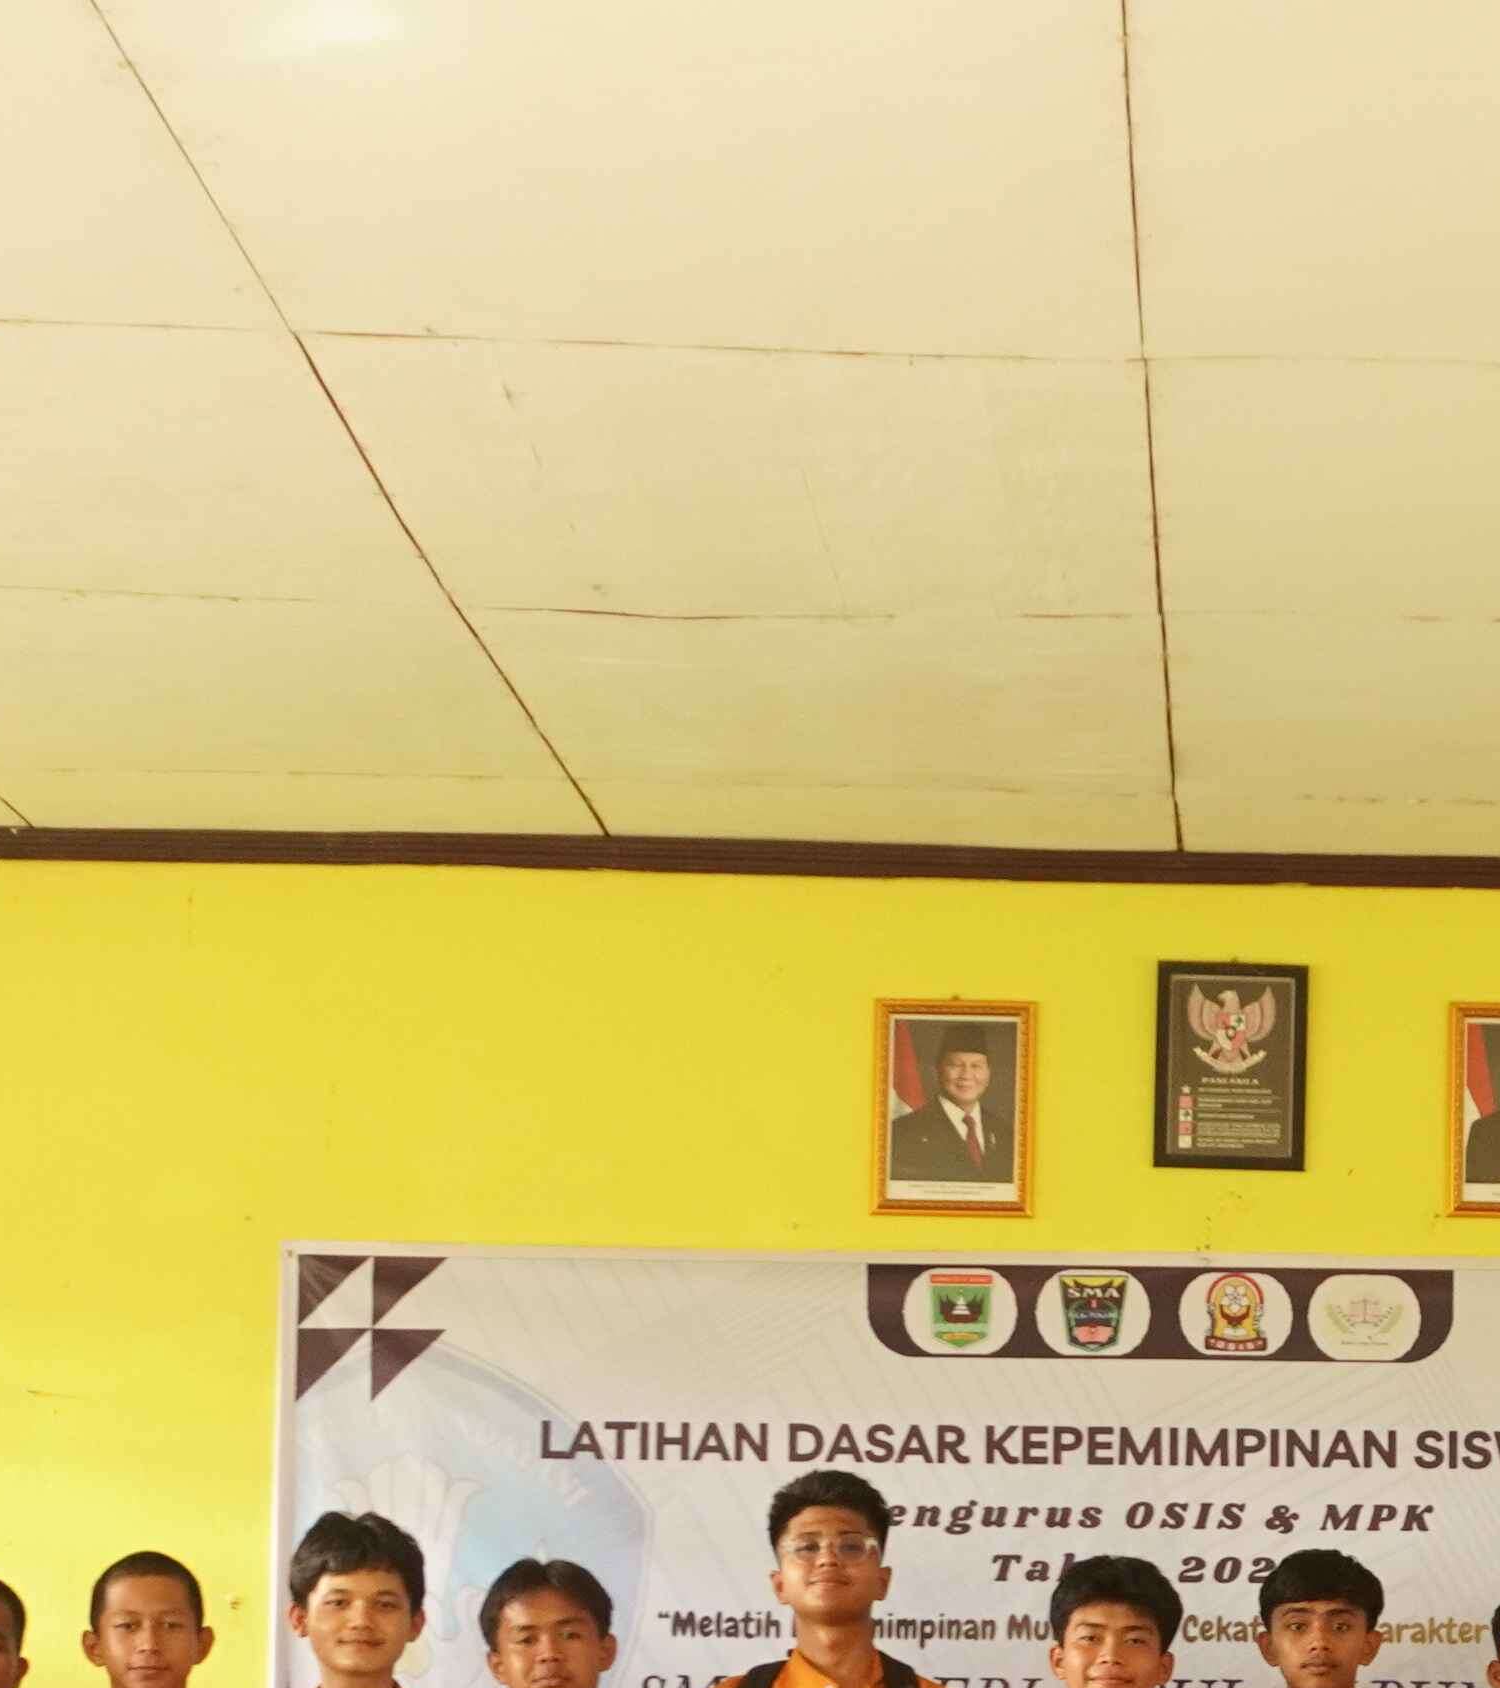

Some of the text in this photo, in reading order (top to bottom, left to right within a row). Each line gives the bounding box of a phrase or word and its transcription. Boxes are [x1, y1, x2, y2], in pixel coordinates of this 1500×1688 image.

[1067, 1287, 1121, 1298] SMA
[541, 1420, 768, 1462] LATIHAN
[788, 1423, 971, 1465] DASAR
[985, 1425, 1397, 1469] KEPEMIMPINAN
[886, 1499, 1434, 1536] engurus OSIS & MPK
[1178, 1556, 1276, 1584] 202
